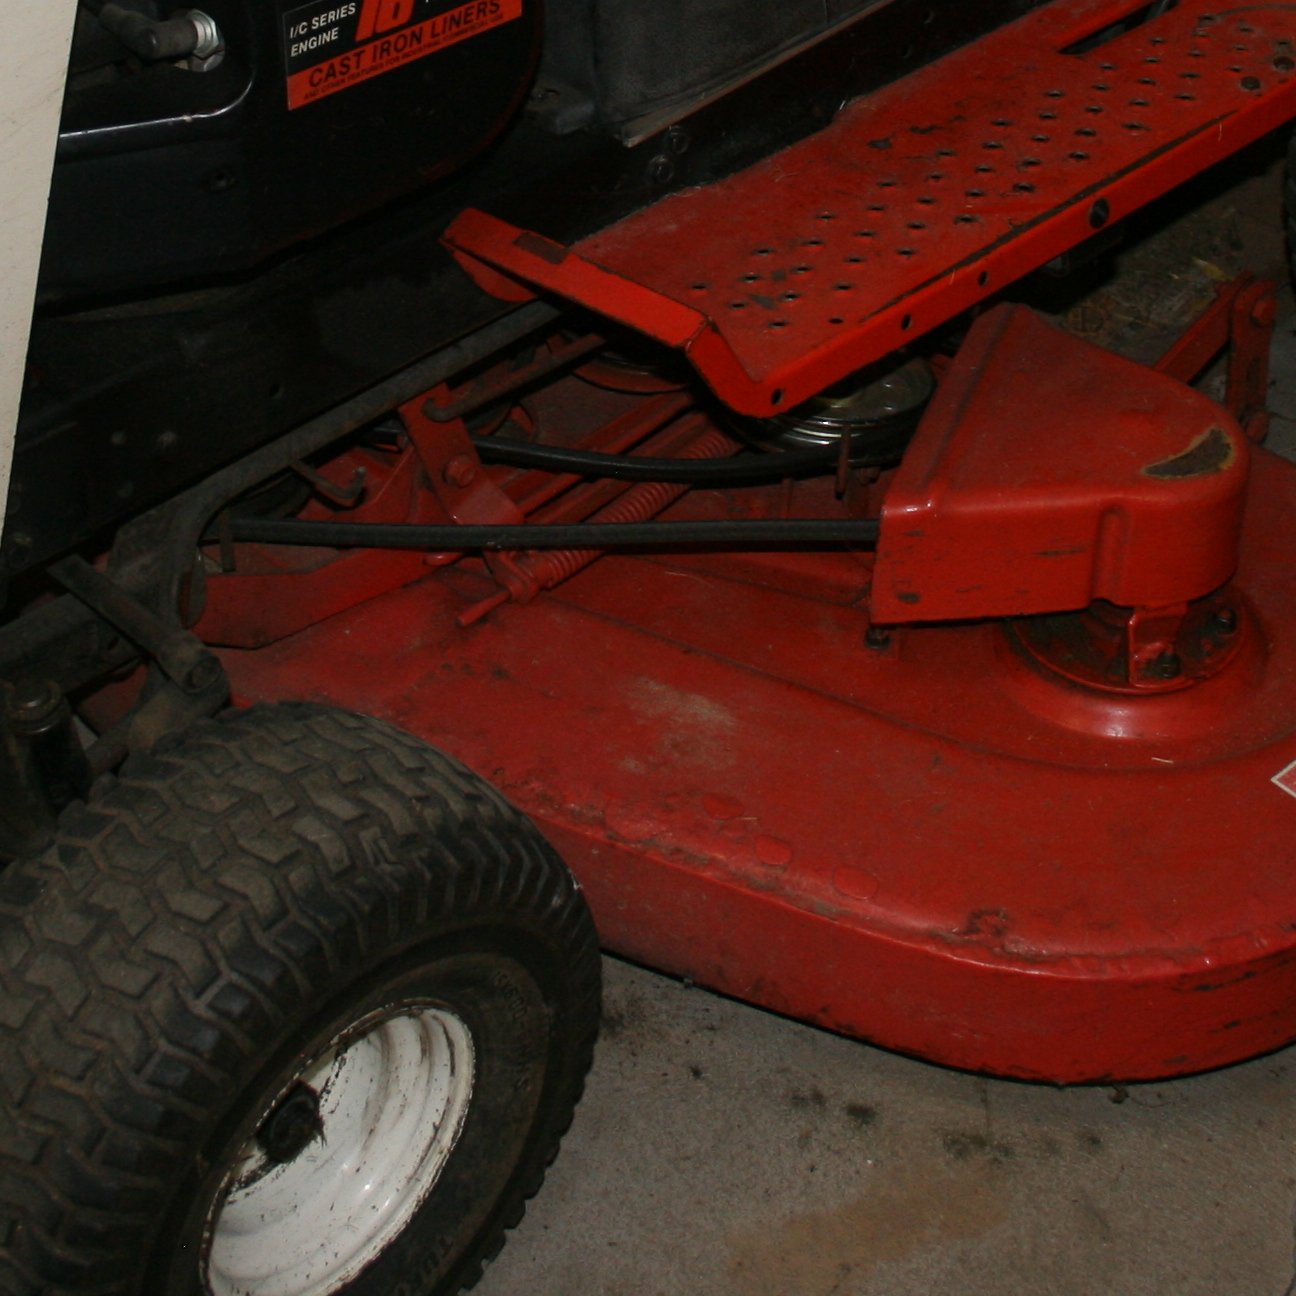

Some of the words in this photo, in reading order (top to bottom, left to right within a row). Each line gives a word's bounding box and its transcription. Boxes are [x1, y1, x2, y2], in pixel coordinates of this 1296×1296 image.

[289, 16, 309, 40] I/C
[310, 2, 357, 30] SERIES
[290, 26, 341, 58] ENGINE
[307, 49, 366, 89] CAST
[371, 30, 424, 64] IRON
